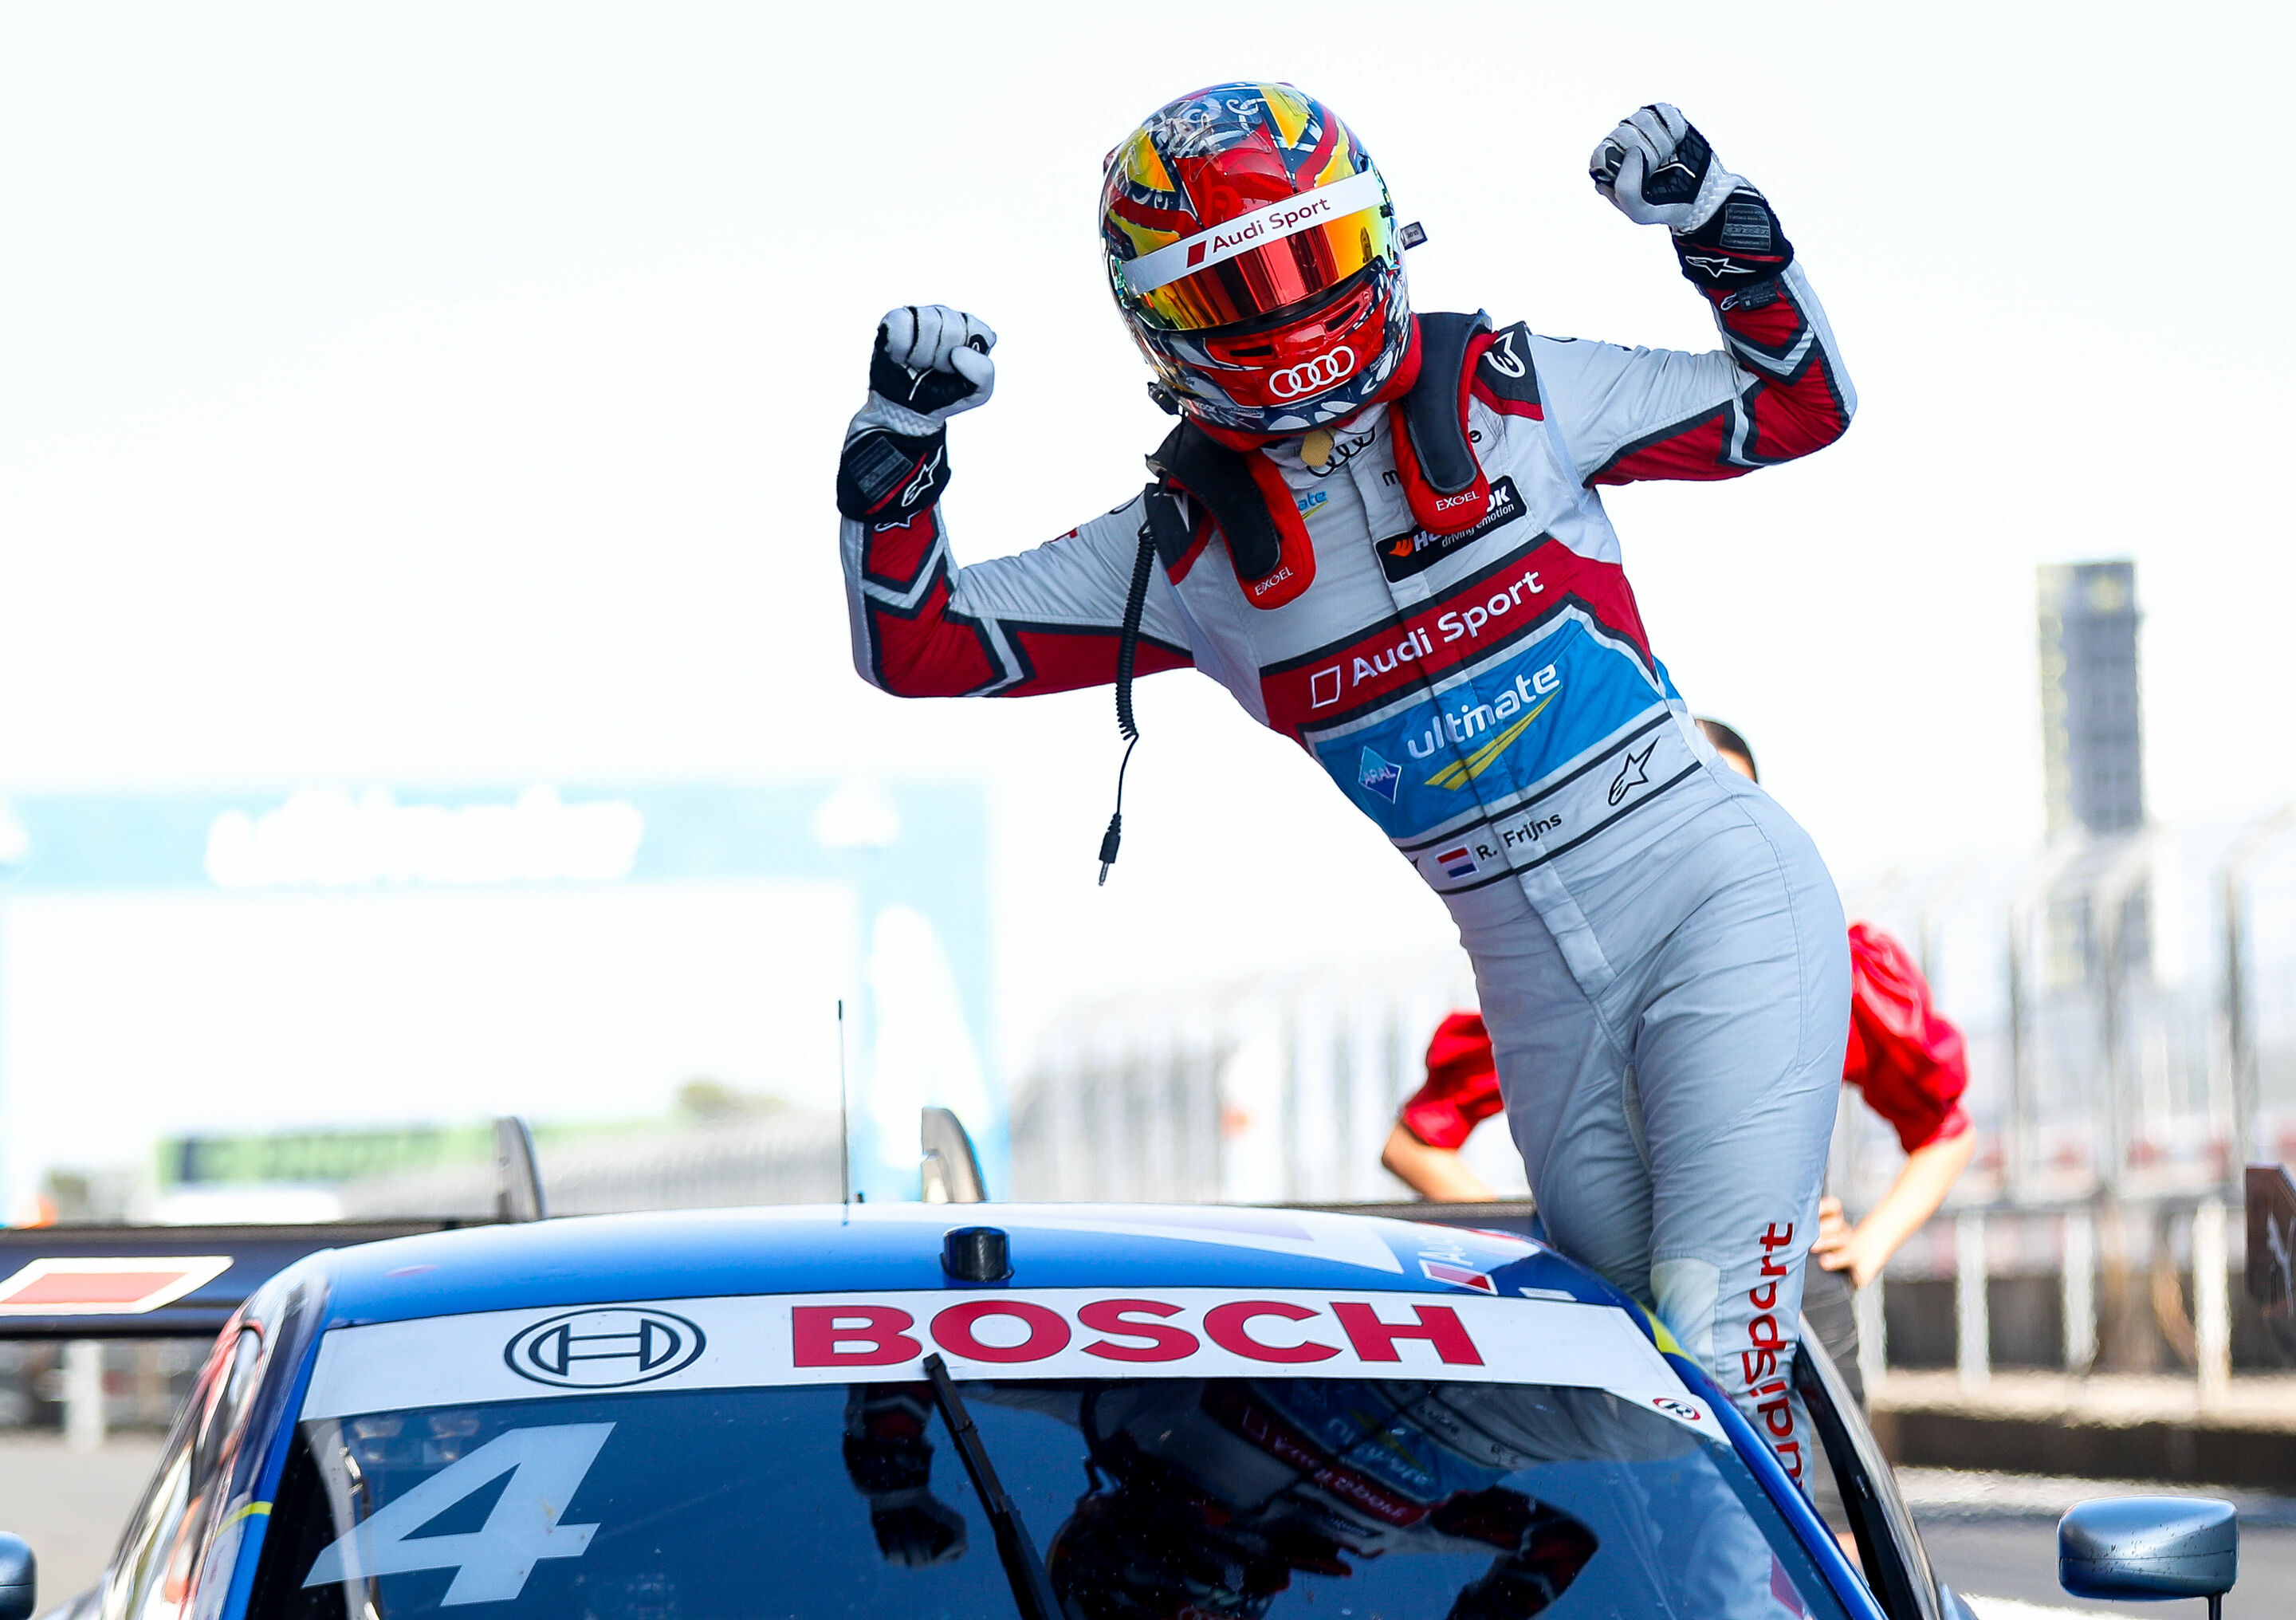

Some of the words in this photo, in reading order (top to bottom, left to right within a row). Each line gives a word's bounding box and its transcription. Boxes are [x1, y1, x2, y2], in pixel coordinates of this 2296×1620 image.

[1213, 219, 1265, 254] Audi
[1268, 198, 1331, 230] Sport
[1435, 490, 1480, 512] EXGEL
[1476, 503, 1515, 529] emotion
[1254, 566, 1294, 596] EXGEL
[1352, 627, 1434, 687] Audi
[1437, 568, 1545, 645] Sport
[1406, 662, 1563, 760] ultimate
[1362, 765, 1397, 788] ARAL
[1475, 843, 1498, 861] R.
[1502, 813, 1563, 848] Frijns
[792, 1298, 1486, 1368] BOSCH
[1750, 1380, 1805, 1490] udi
[301, 1421, 617, 1608] 4
